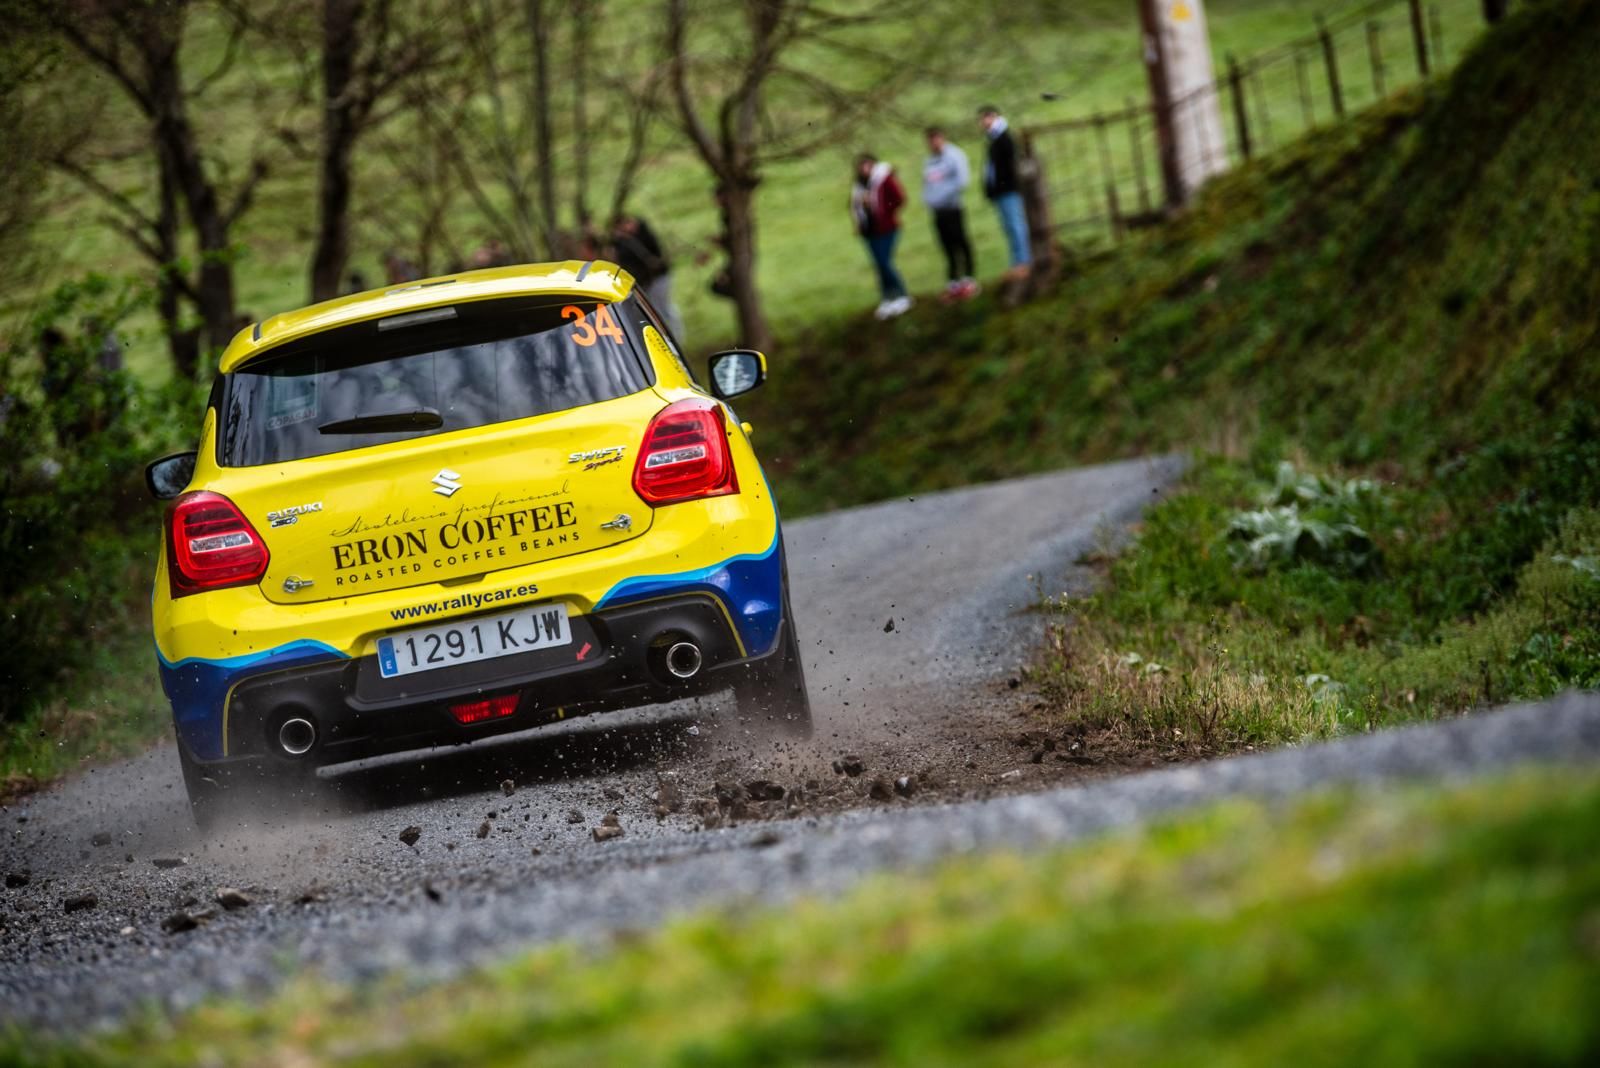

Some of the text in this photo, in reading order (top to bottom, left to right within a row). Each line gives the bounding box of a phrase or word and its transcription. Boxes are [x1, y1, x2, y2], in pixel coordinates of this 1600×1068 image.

[561, 303, 624, 347] 34
[568, 445, 627, 464] SWIFT
[266, 502, 323, 521] SUZUKI
[331, 501, 577, 571] ERON COFFEE
[336, 531, 580, 586] ROASTED COFFEE BEANS
[390, 583, 538, 621] www.rallycar.es
[406, 610, 561, 667] 1291 KJW
